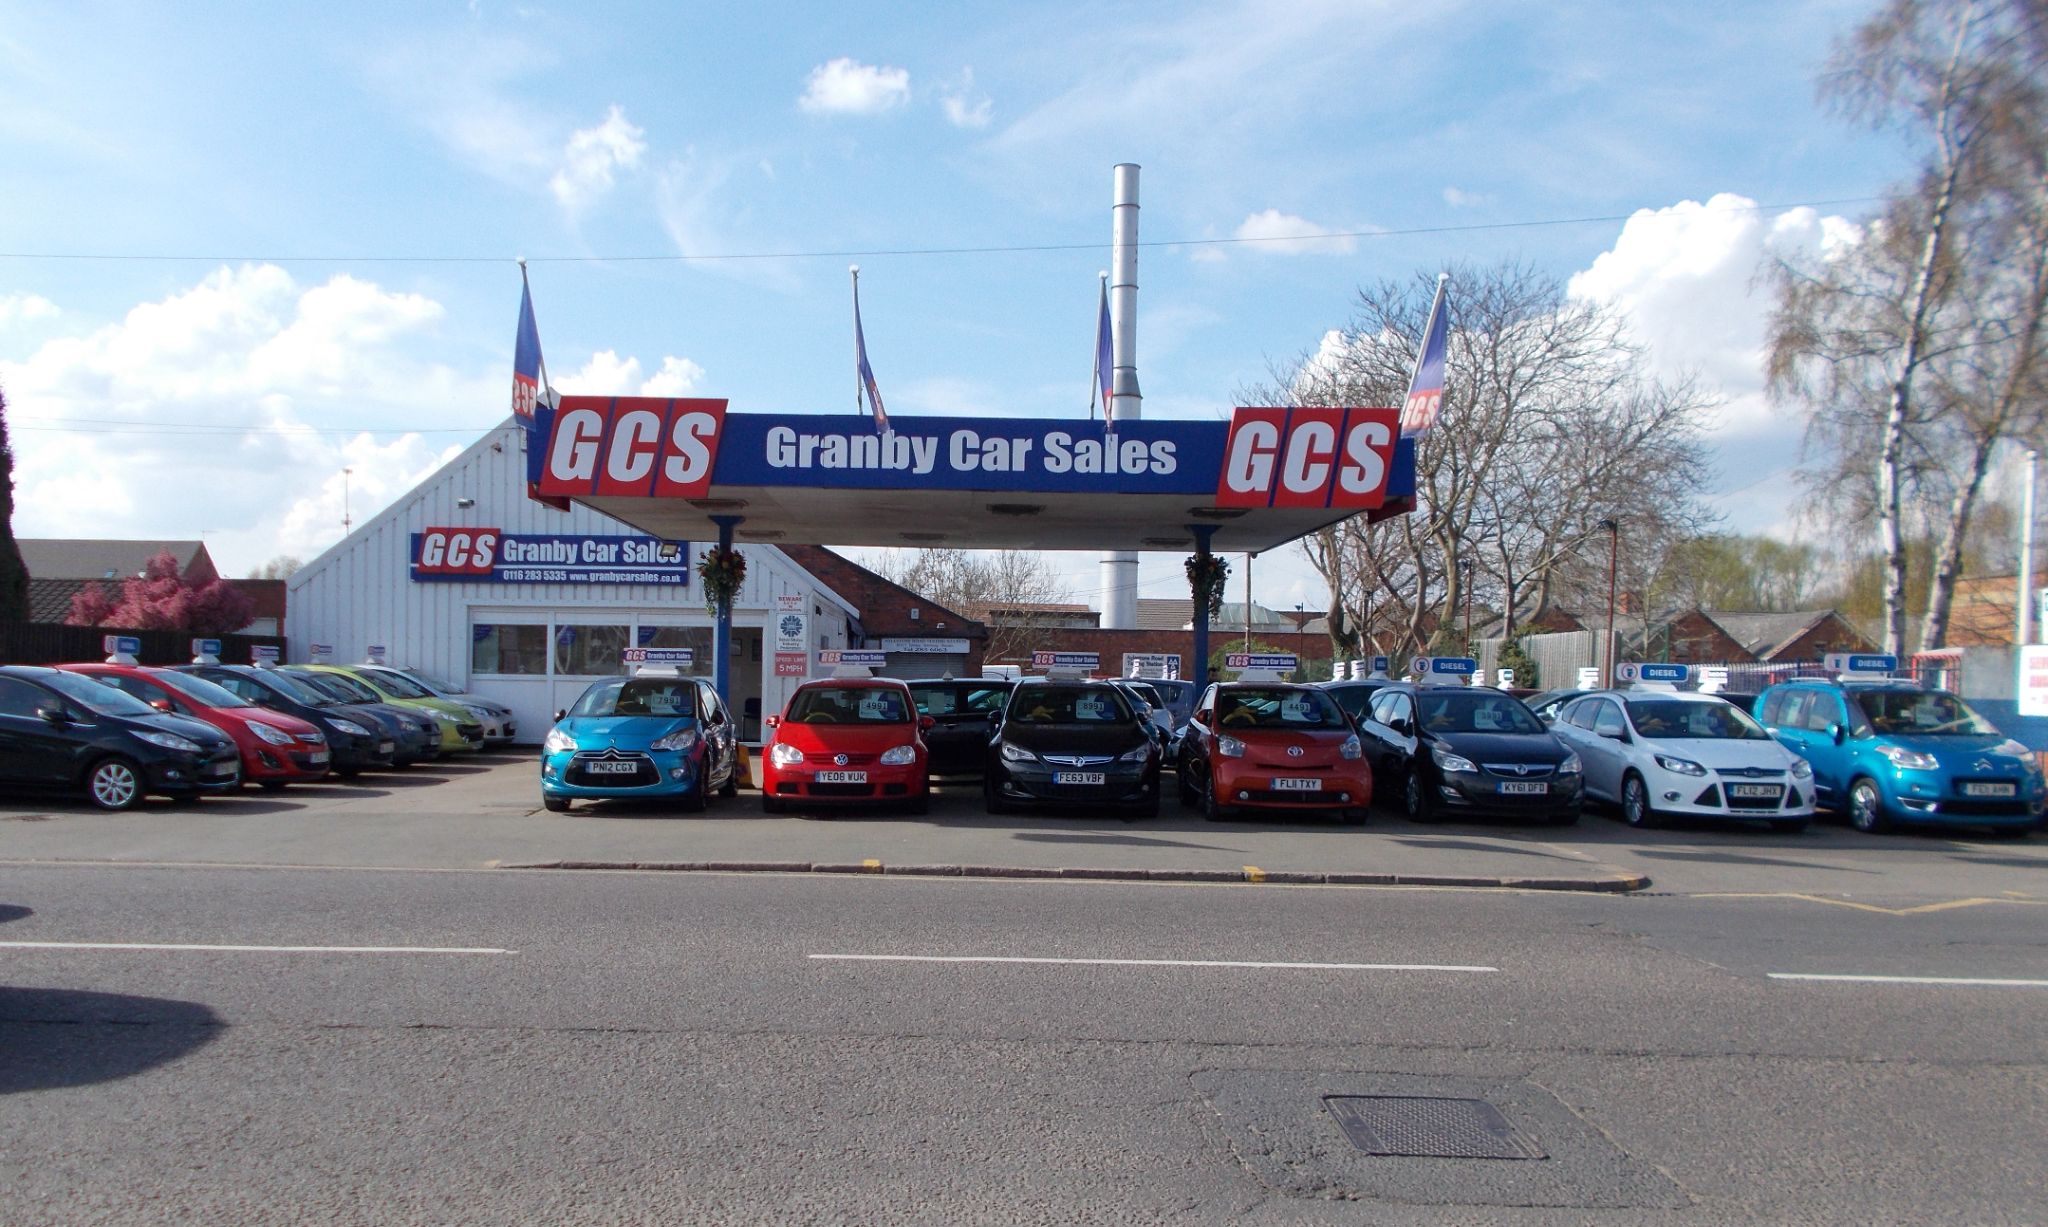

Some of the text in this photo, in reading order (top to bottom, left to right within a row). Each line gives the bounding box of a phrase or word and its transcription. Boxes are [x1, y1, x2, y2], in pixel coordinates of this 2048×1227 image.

[550, 409, 717, 484] GCS
[766, 426, 1178, 476] Granby Car Sales
[1226, 420, 1391, 494] GCS
[422, 533, 497, 568] GCS
[504, 539, 578, 565] Granby
[582, 540, 619, 563] Car
[503, 570, 524, 581] 0116
[525, 570, 542, 581] 283
[543, 571, 567, 581] 5335
[626, 650, 646, 661] GCS
[821, 652, 841, 663] GCS
[1035, 654, 1055, 664] GCS
[1228, 655, 1249, 666] GCS
[779, 664, 803, 672] 5 MPH
[1440, 662, 1468, 670] DIESEL
[1857, 659, 1887, 668] DIESEL
[1649, 669, 1678, 677] DIESEL
[592, 763, 634, 772] PN12 CGX
[822, 772, 865, 782] YE08 WUK
[1059, 773, 1103, 783] FE63 VBF
[1280, 779, 1317, 789] FL11 TXY
[1504, 783, 1526, 792] KY61
